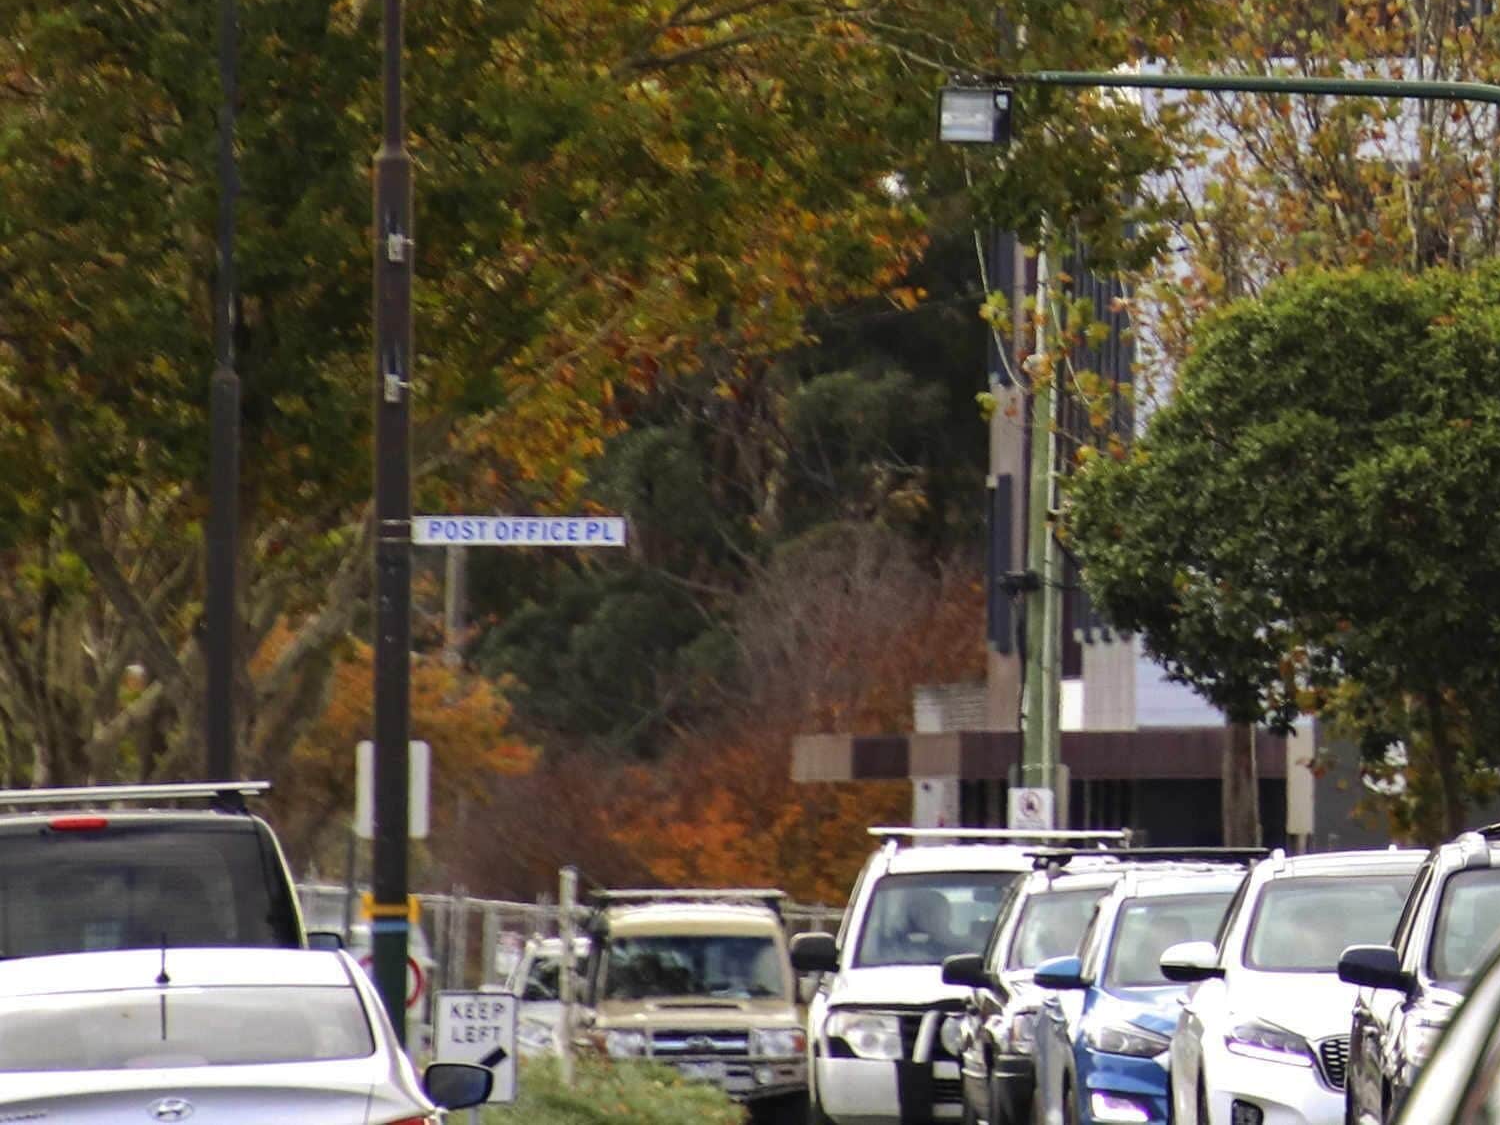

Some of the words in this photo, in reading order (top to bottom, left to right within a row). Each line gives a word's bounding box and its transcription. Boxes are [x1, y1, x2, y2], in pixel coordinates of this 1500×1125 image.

[429, 521, 486, 540] POST
[495, 521, 579, 542] OFFICE
[586, 522, 615, 542] PL
[451, 1002, 505, 1020] KEEP
[451, 1026, 501, 1044] LEFT
